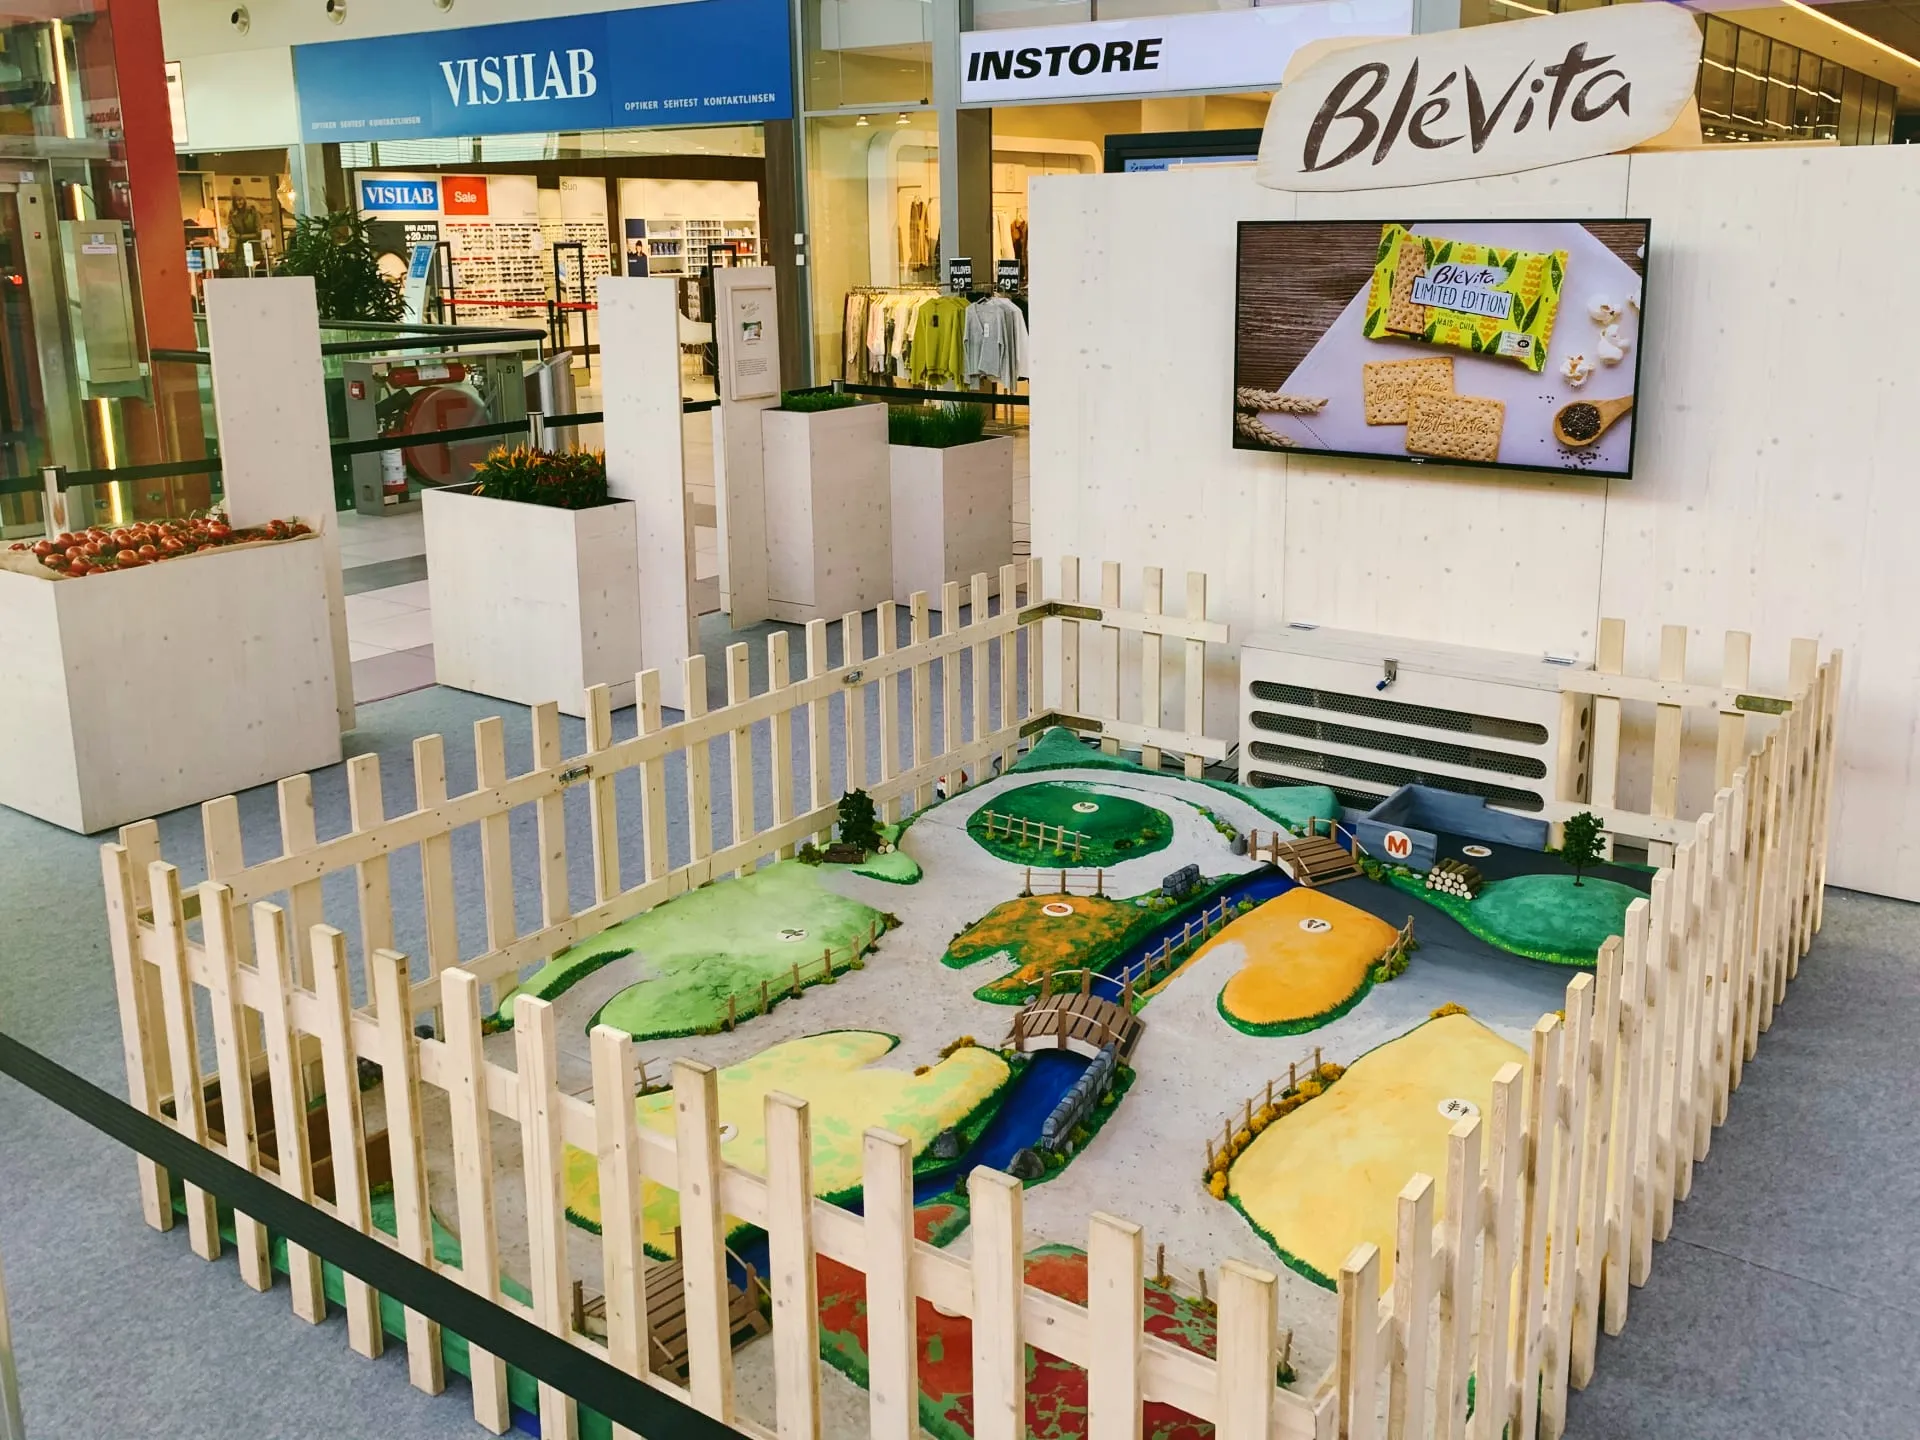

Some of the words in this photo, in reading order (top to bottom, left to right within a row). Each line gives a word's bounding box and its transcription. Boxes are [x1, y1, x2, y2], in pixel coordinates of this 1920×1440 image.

[967, 38, 1163, 81] INSTORE
[439, 48, 597, 107] VISILAB
[624, 101, 659, 111] OPTIKER
[663, 98, 698, 109] SEHTEST
[704, 93, 776, 106] KONTAKTLINSEN
[1296, 41, 1631, 173] BléVita
[365, 187, 434, 204] VISILAB
[561, 181, 578, 191] Sun
[454, 191, 477, 203] Sale
[1432, 265, 1495, 286] BléVita
[1414, 282, 1457, 306] LIMITED
[1460, 289, 1509, 315] EDITION
[1436, 317, 1454, 328] MAIS
[1459, 321, 1475, 331] CHIA
[1387, 835, 1408, 856] M
